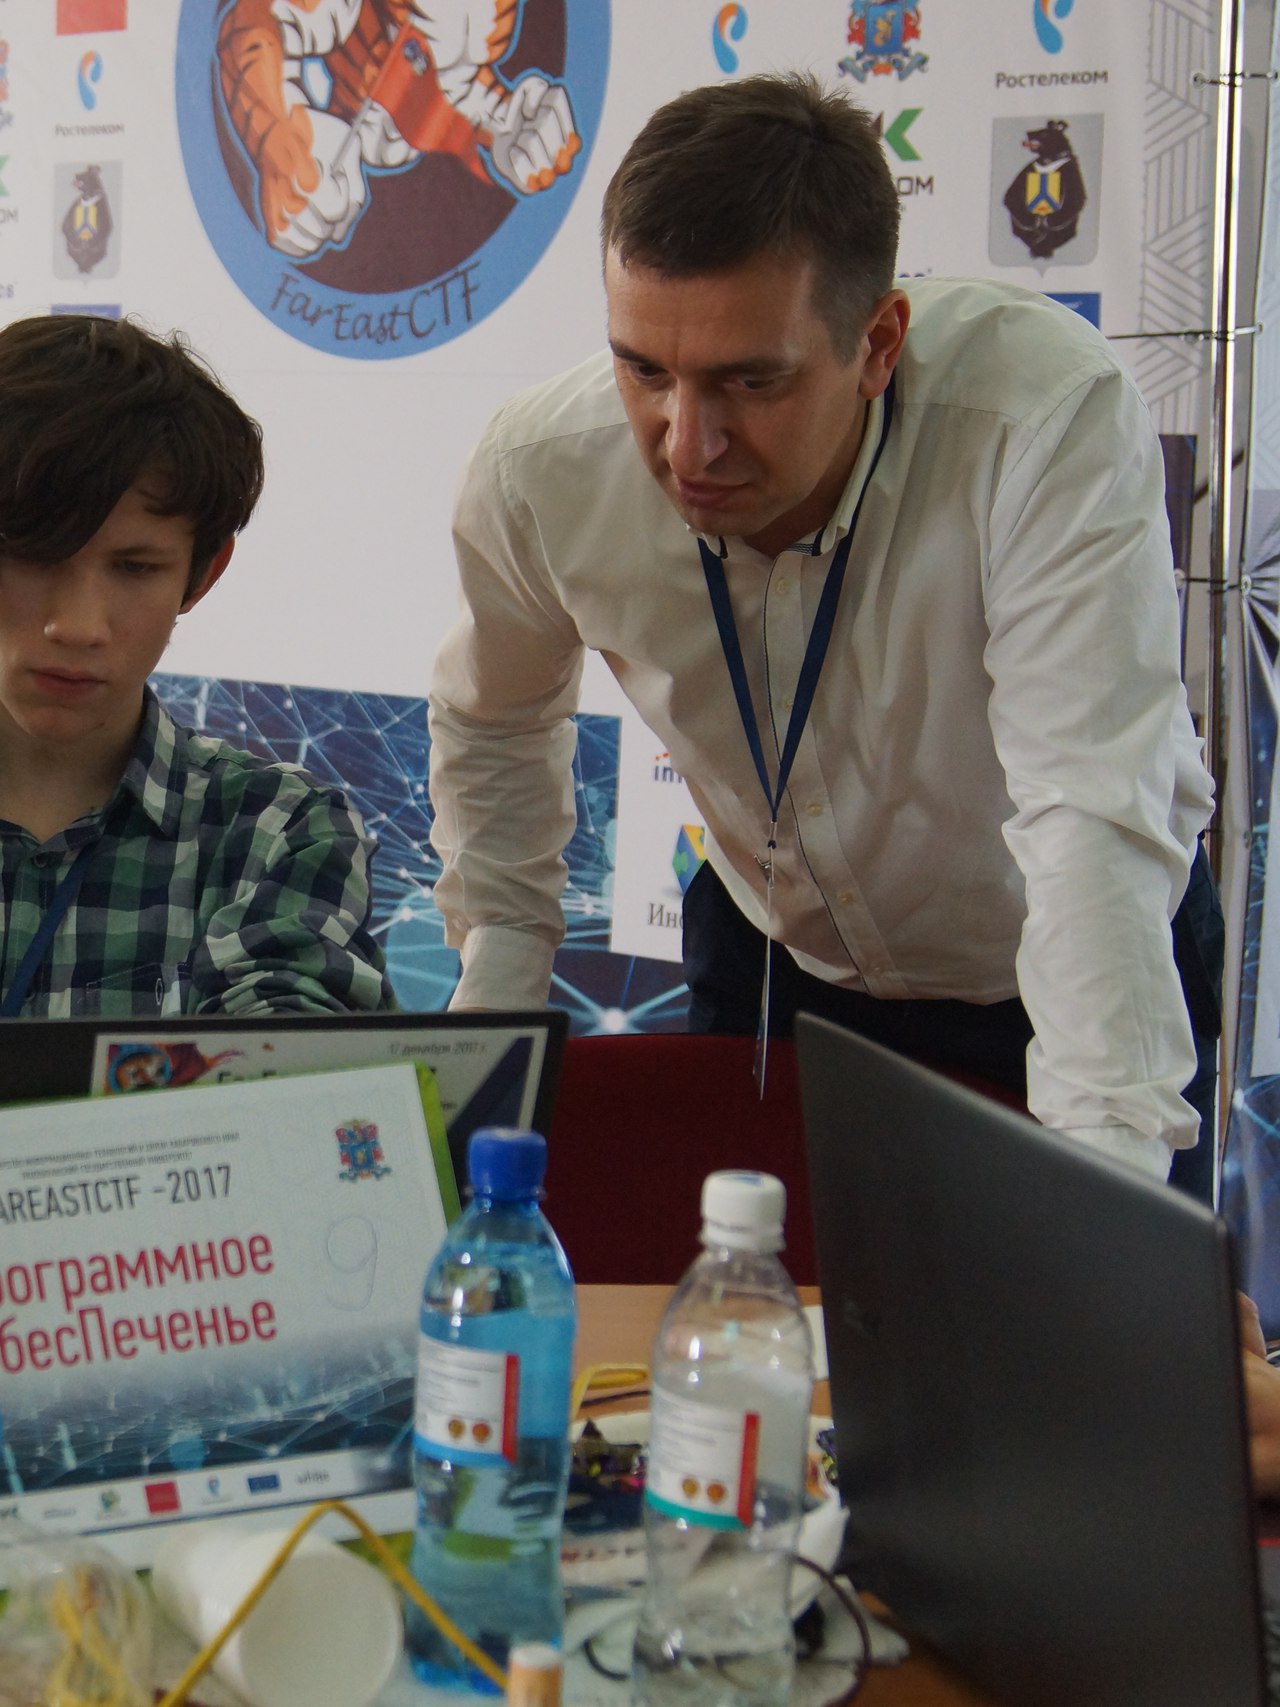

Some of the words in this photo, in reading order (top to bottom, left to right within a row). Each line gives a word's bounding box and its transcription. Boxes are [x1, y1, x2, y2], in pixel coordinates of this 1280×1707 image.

[994, 69, 1109, 89] Ростелеком
[54, 123, 125, 137] Ростелеком
[270, 260, 482, 344] FarEastCTF
